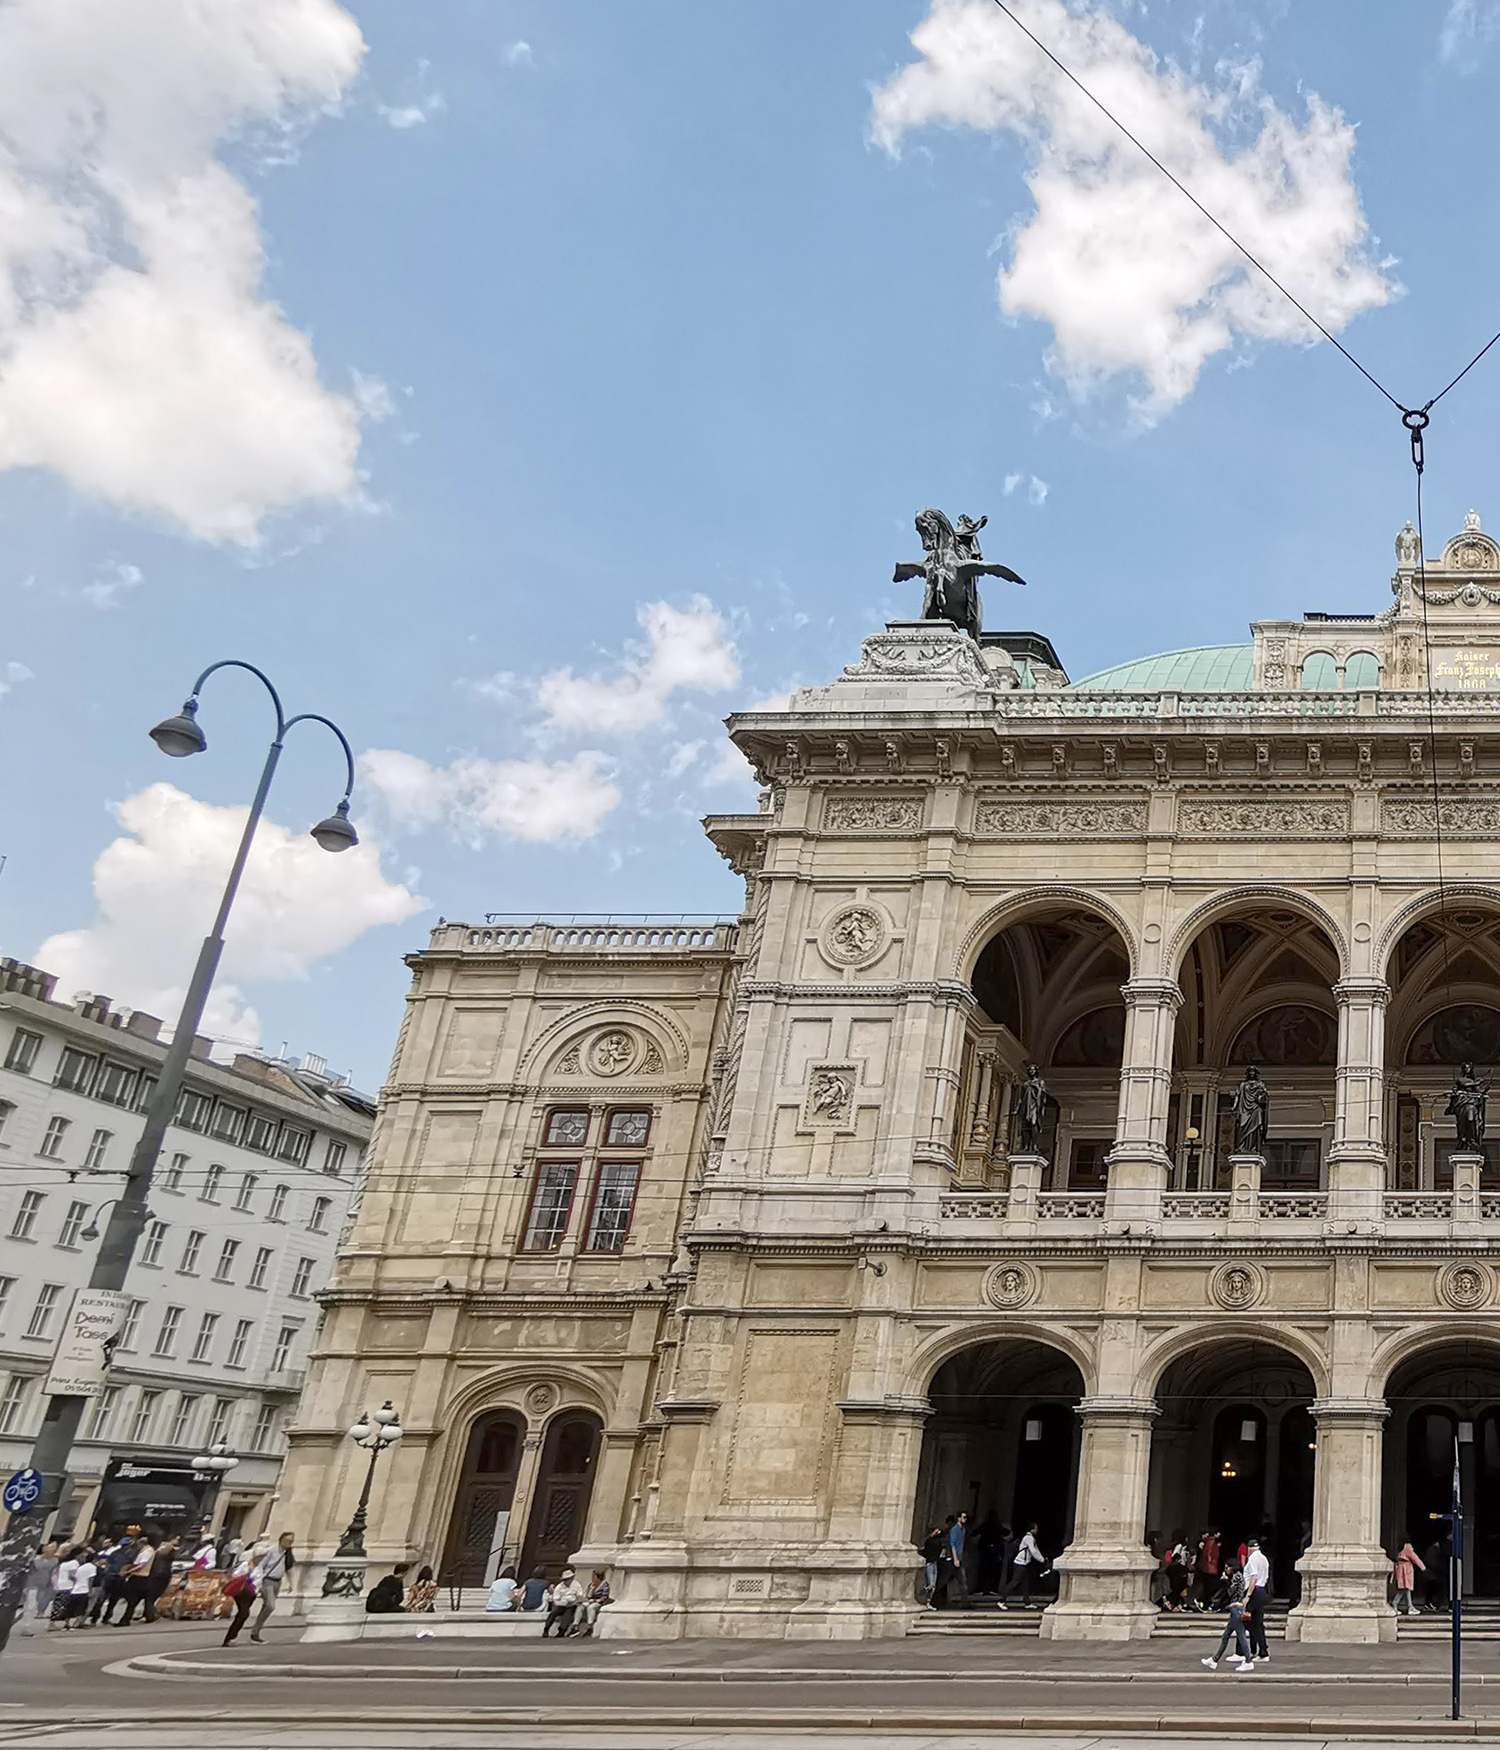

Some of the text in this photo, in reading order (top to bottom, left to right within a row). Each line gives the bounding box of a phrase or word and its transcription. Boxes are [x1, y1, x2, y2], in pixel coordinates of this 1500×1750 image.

[1454, 650, 1490, 662] Kaiser
[1435, 662, 1464, 680] Franz
[1458, 679, 1487, 689] 1868
[74, 1311, 116, 1325] Demi
